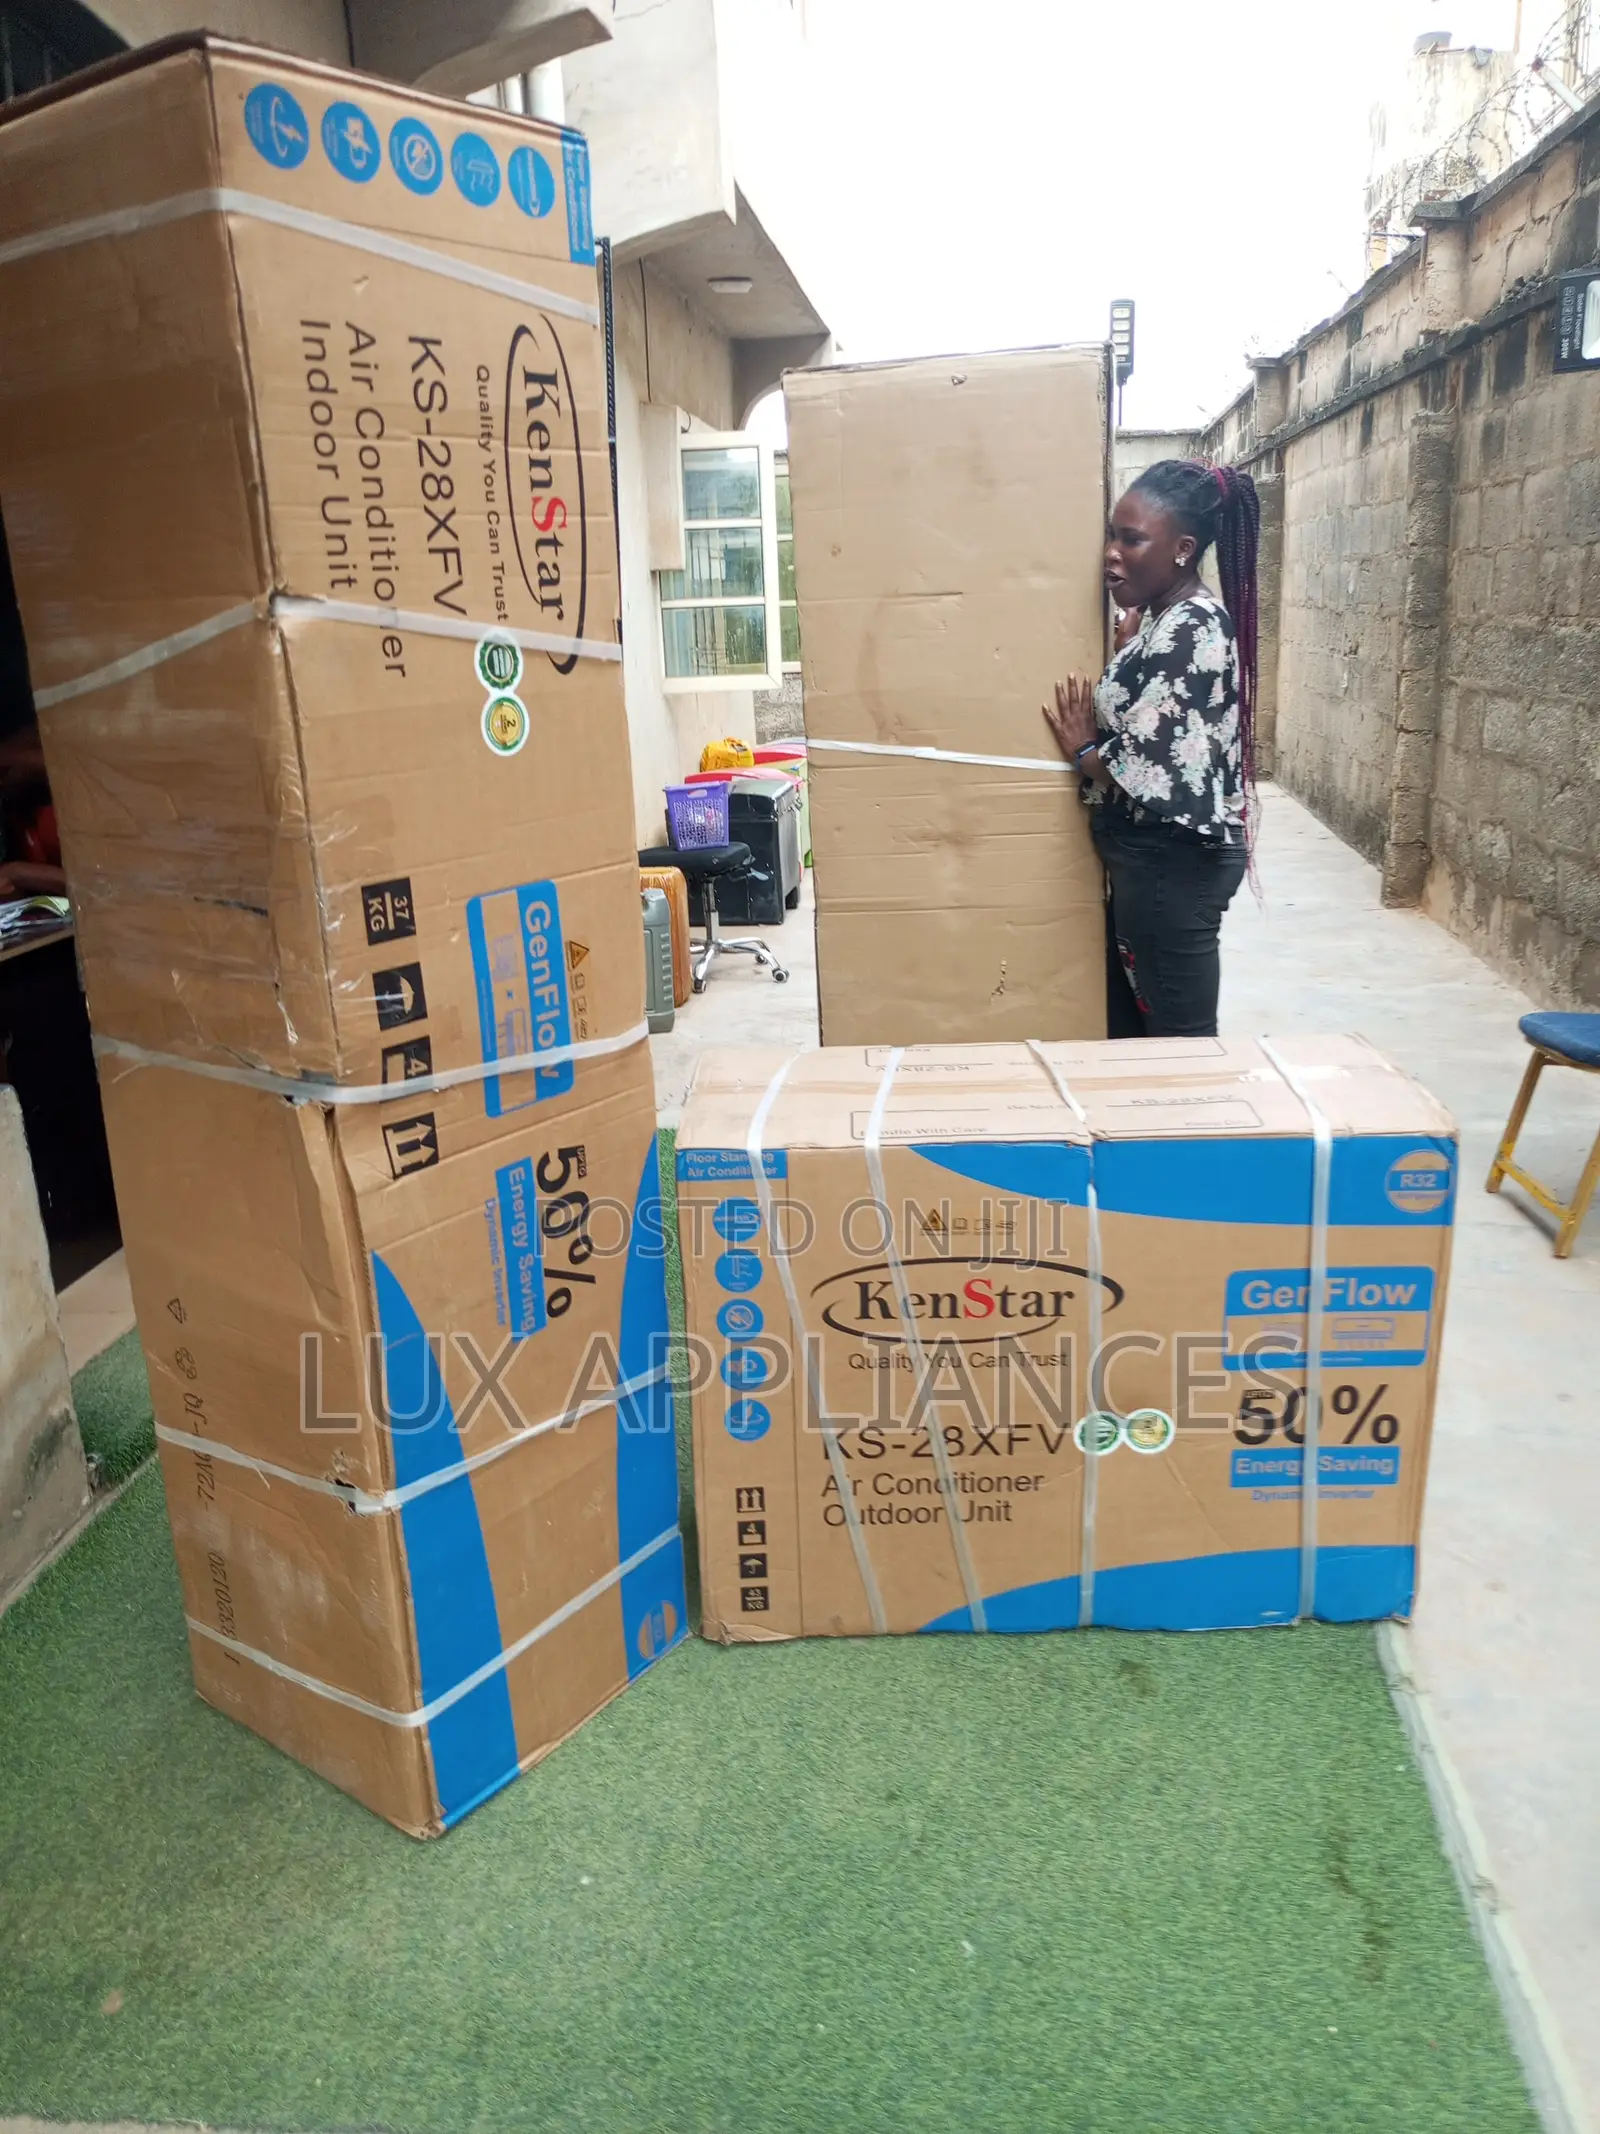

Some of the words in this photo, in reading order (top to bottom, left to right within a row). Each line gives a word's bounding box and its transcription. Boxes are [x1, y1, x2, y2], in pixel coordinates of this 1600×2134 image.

[345, 320, 379, 393] Air
[476, 363, 495, 456] Quality
[300, 319, 341, 481] Indoor
[321, 496, 358, 590] Unit
[407, 334, 468, 617] KS-28XFV
[482, 460, 495, 504] You
[523, 364, 568, 622] KenStar
[355, 408, 406, 679] Conditioer
[487, 510, 501, 555] Can
[493, 560, 510, 622] Trust
[368, 896, 386, 933] KG
[394, 894, 410, 920] 37
[686, 1152, 718, 1164] Floor
[688, 1167, 705, 1178] Air
[509, 1166, 529, 1248] Energy
[519, 1252, 537, 1331] Saving
[536, 1145, 597, 1319] 50%
[854, 1277, 1075, 1322] KenStar
[848, 1352, 917, 1372] Quality
[925, 1352, 962, 1369] You
[968, 1352, 1009, 1369] Can
[1015, 1351, 1068, 1368] Trust
[1233, 1383, 1399, 1446] 50%
[1235, 1457, 1307, 1477] Energ
[1318, 1455, 1395, 1476] Saving
